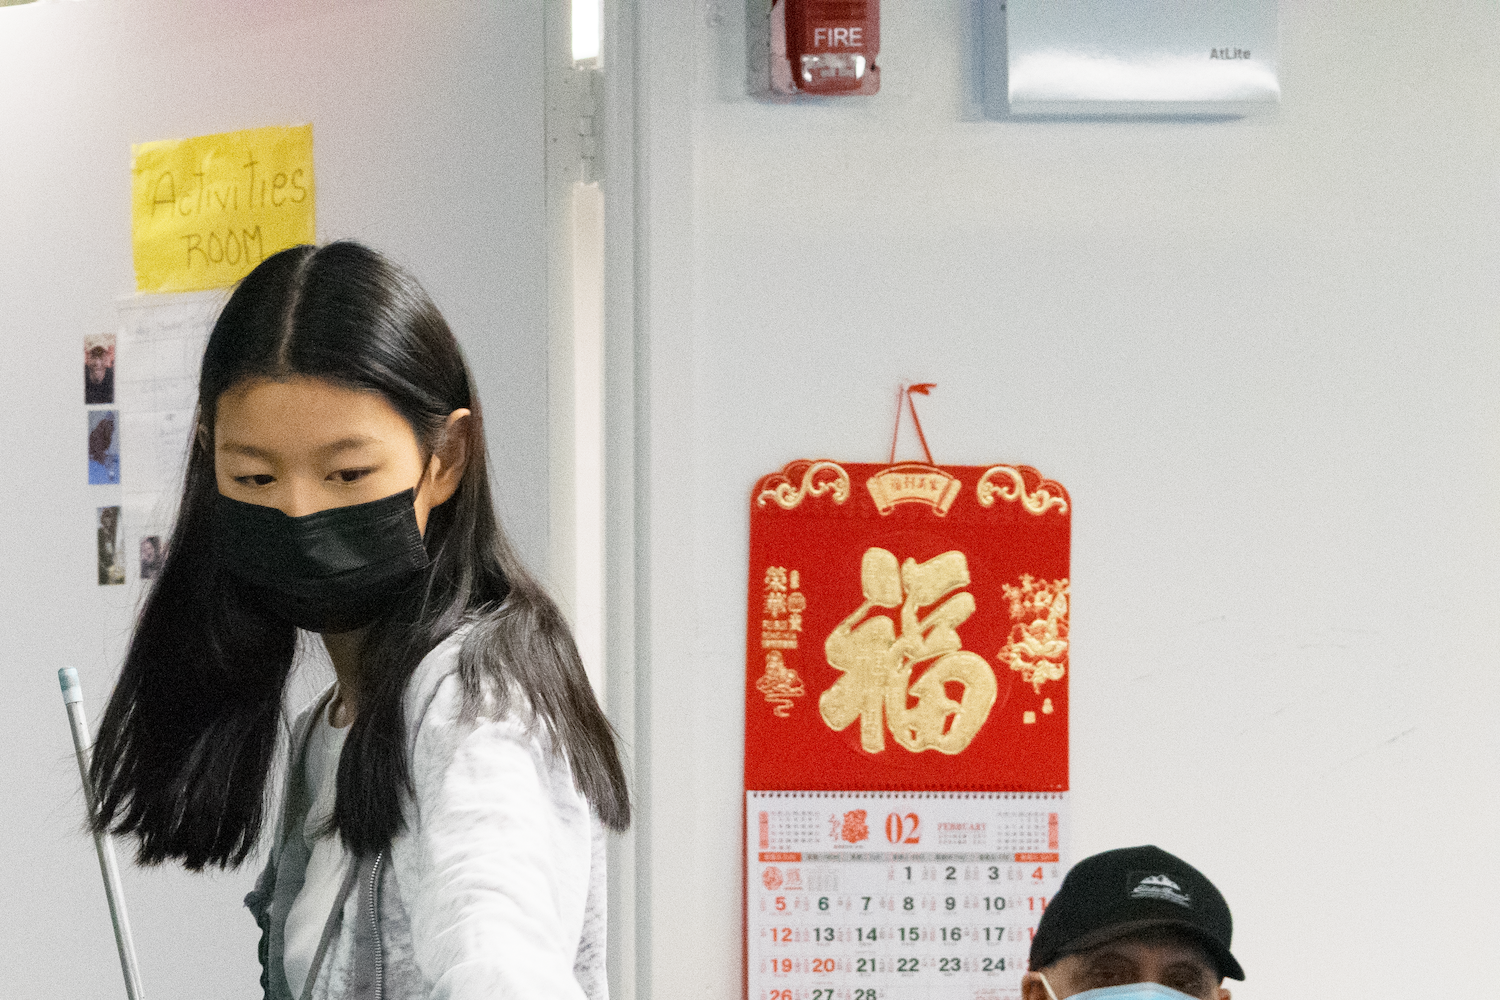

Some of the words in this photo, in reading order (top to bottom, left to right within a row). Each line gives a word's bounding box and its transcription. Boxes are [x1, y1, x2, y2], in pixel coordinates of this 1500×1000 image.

[813, 27, 863, 47] FIRE
[180, 225, 264, 269] ROOM
[818, 546, 999, 756] 福
[884, 811, 920, 845] 02
[904, 865, 912, 880] 1
[945, 865, 957, 880] 2
[988, 865, 999, 880] 3
[1031, 865, 1044, 880] 4
[775, 896, 787, 911] 5
[818, 896, 829, 911] 6
[861, 896, 872, 911] 7
[903, 896, 915, 911] 8
[945, 896, 956, 911] 9
[983, 896, 1006, 911] 10
[770, 927, 793, 942] 12
[813, 927, 835, 942] 13
[855, 927, 877, 942] 14
[898, 927, 920, 941] 15
[939, 927, 962, 941] 16
[983, 927, 1005, 941] 17
[771, 958, 793, 973] 19
[812, 958, 835, 973] 20
[856, 958, 877, 973] 21
[897, 958, 920, 972] 22
[939, 958, 962, 972] 23
[982, 958, 1006, 972] 24
